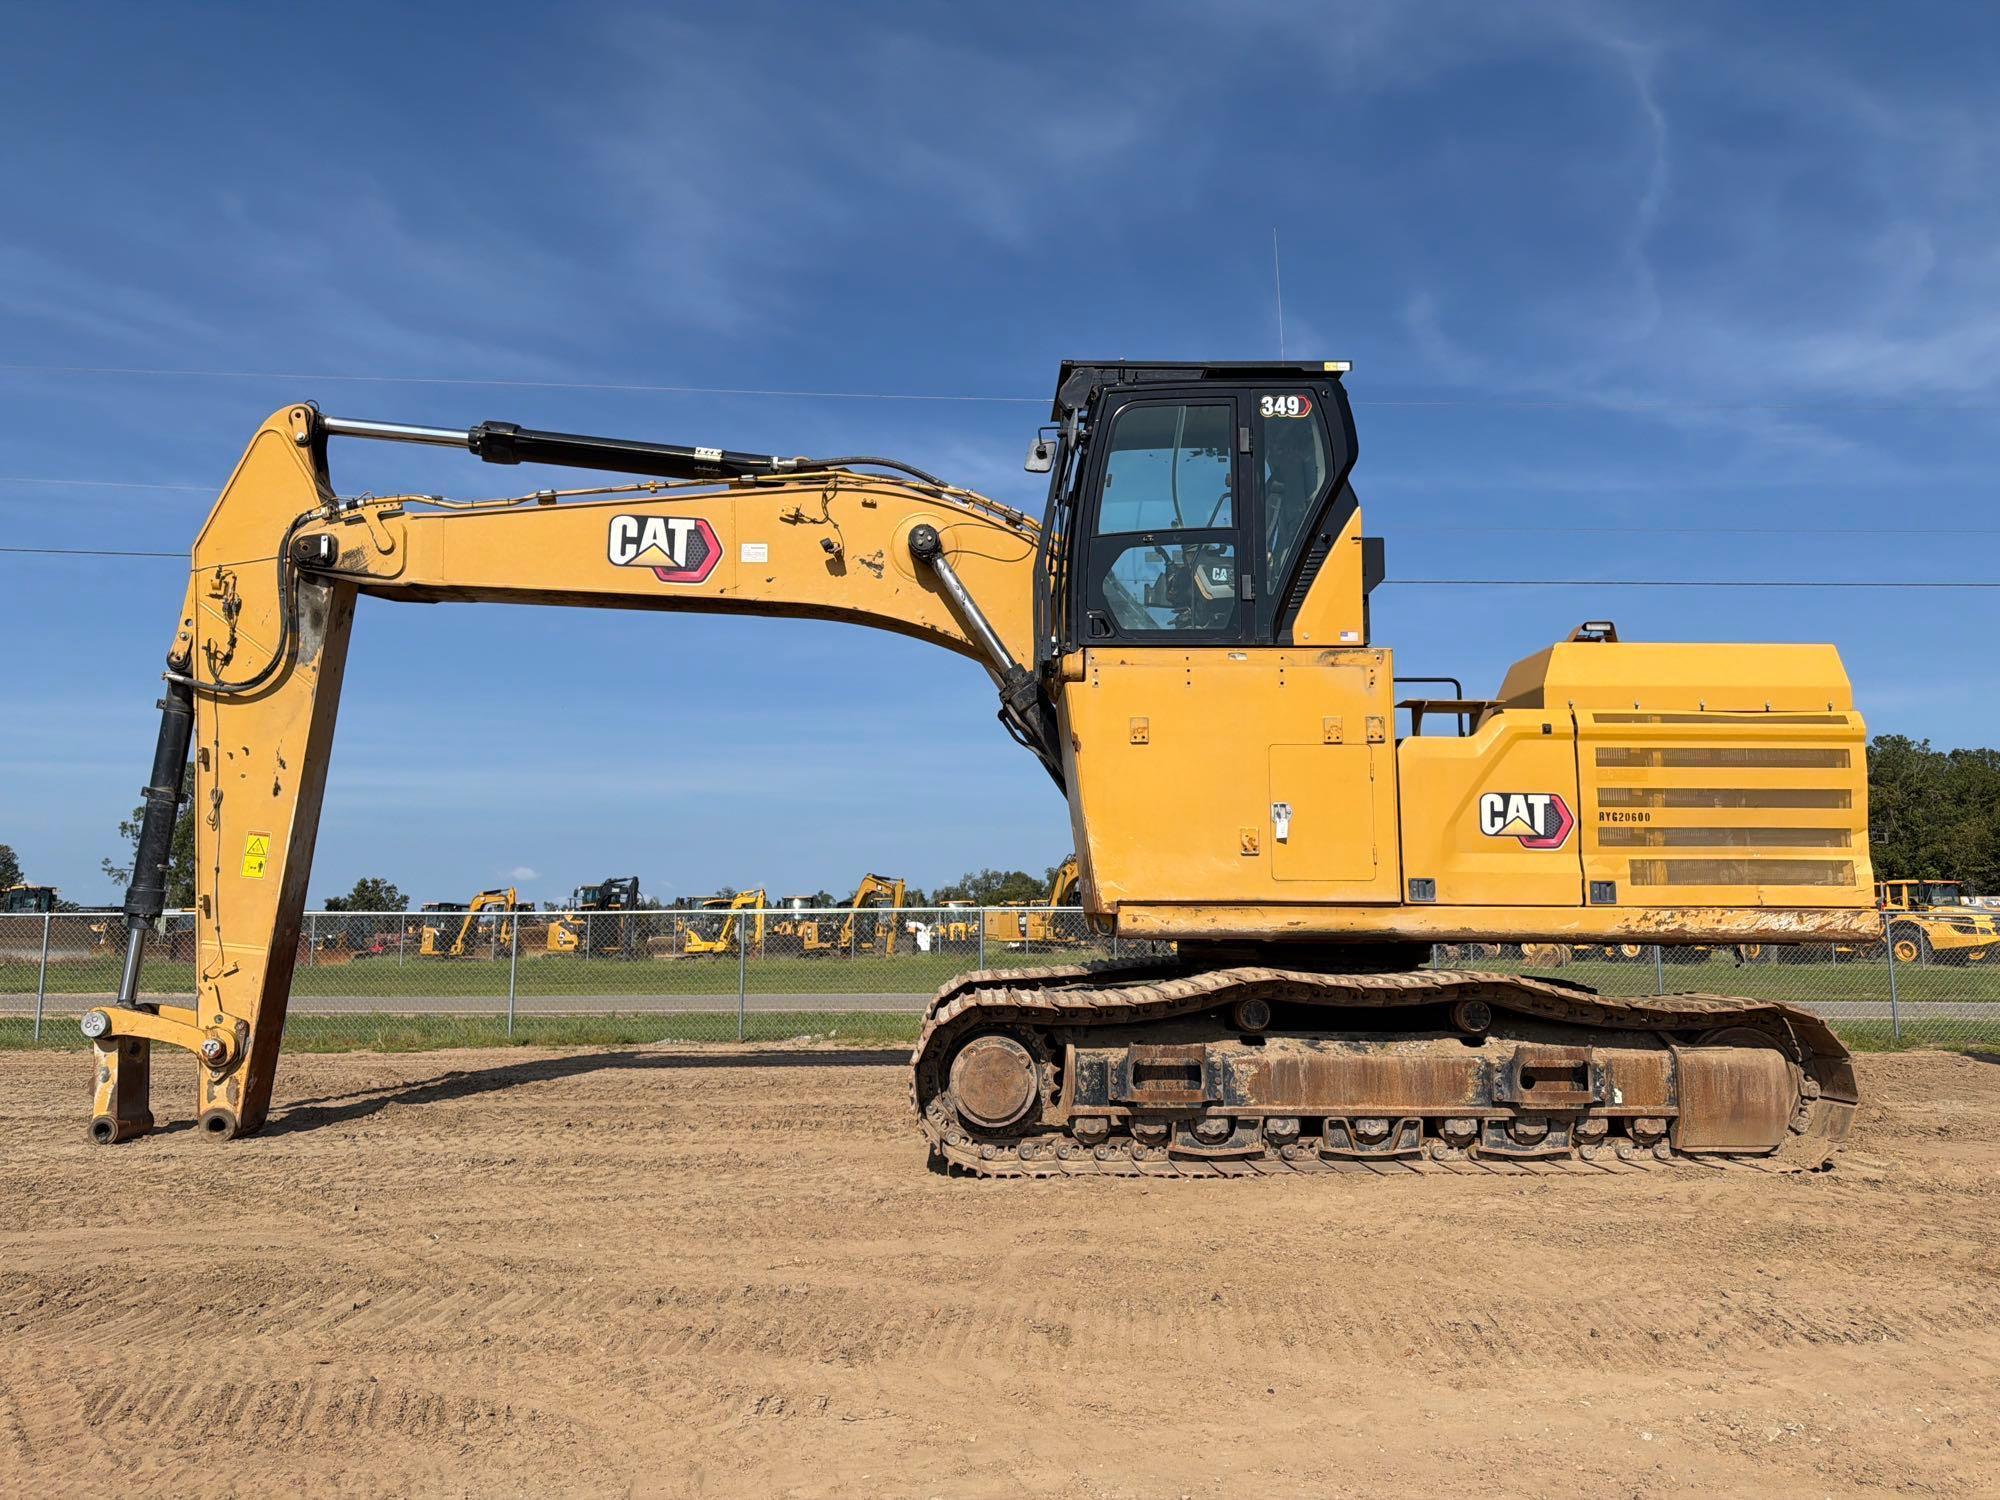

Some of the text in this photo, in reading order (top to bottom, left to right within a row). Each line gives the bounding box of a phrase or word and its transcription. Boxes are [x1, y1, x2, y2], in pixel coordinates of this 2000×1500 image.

[1260, 395, 1300, 416] 349
[609, 515, 695, 568] CAT
[1212, 567, 1229, 581] CA
[1481, 793, 1550, 836] CAT
[1599, 811, 1651, 822] RYG20600
